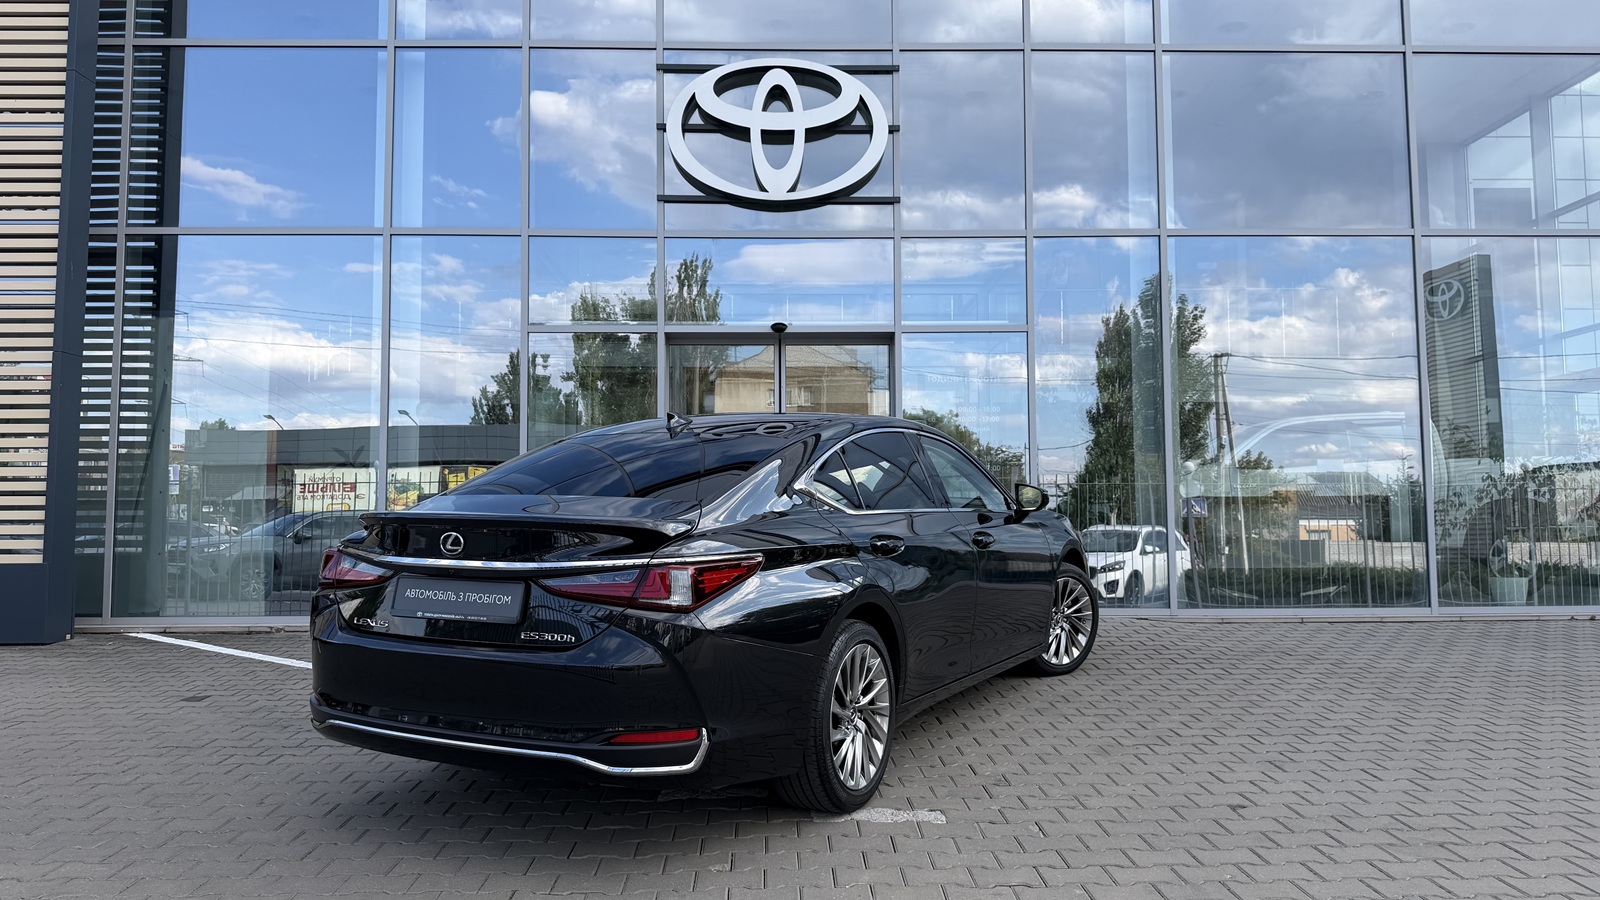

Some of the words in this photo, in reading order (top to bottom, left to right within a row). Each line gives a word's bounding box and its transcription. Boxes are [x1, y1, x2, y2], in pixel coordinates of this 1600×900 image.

[404, 588, 457, 601] АВТОМОБІЛЬ
[465, 592, 512, 605] ПРОБІГОМ
[353, 617, 389, 628] LEXUS
[520, 631, 576, 643] ES300h
